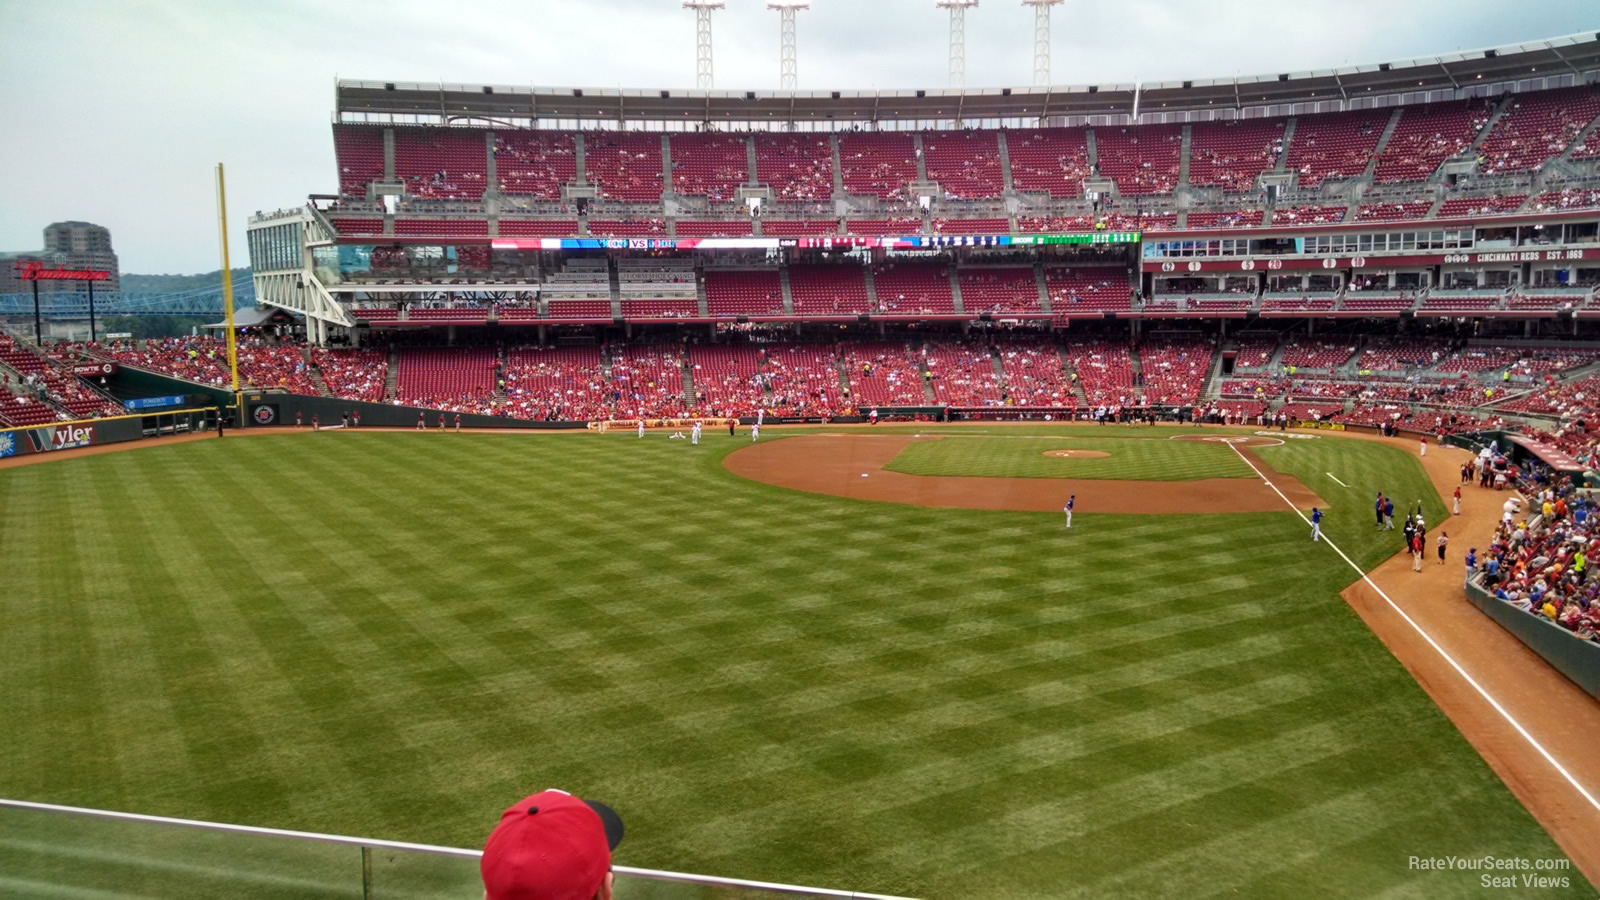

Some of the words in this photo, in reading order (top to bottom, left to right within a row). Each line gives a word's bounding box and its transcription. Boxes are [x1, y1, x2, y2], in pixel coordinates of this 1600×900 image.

[631, 240, 646, 248] VS
[1477, 251, 1518, 262] CINCINNATI
[1520, 251, 1540, 260] REDS
[1546, 250, 1564, 260] EST.
[1566, 249, 1583, 259] 1869
